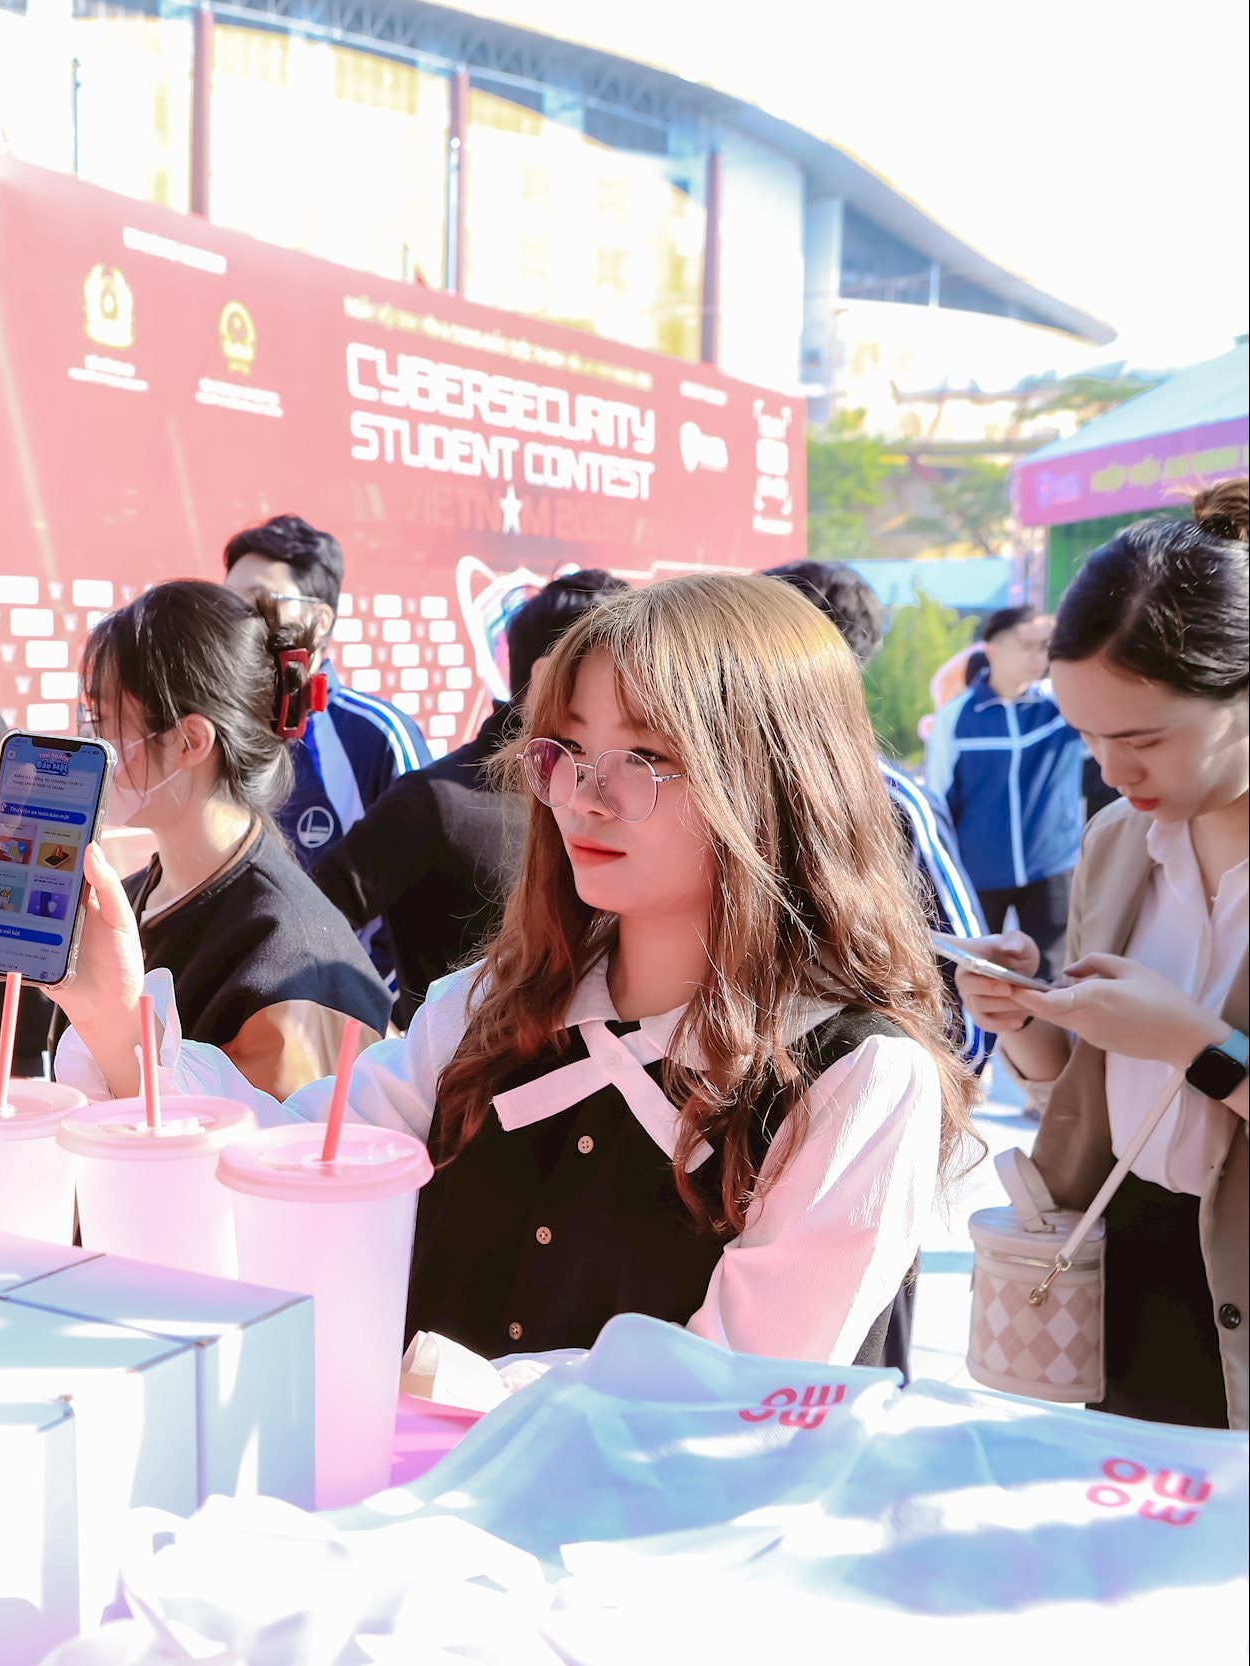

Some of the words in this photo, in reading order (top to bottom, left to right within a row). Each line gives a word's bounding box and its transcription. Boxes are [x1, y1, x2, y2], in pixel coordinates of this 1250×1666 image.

[346, 341, 655, 454] CYBERSECURITY
[350, 410, 520, 482] STUDENT
[523, 441, 655, 501] CONTEST
